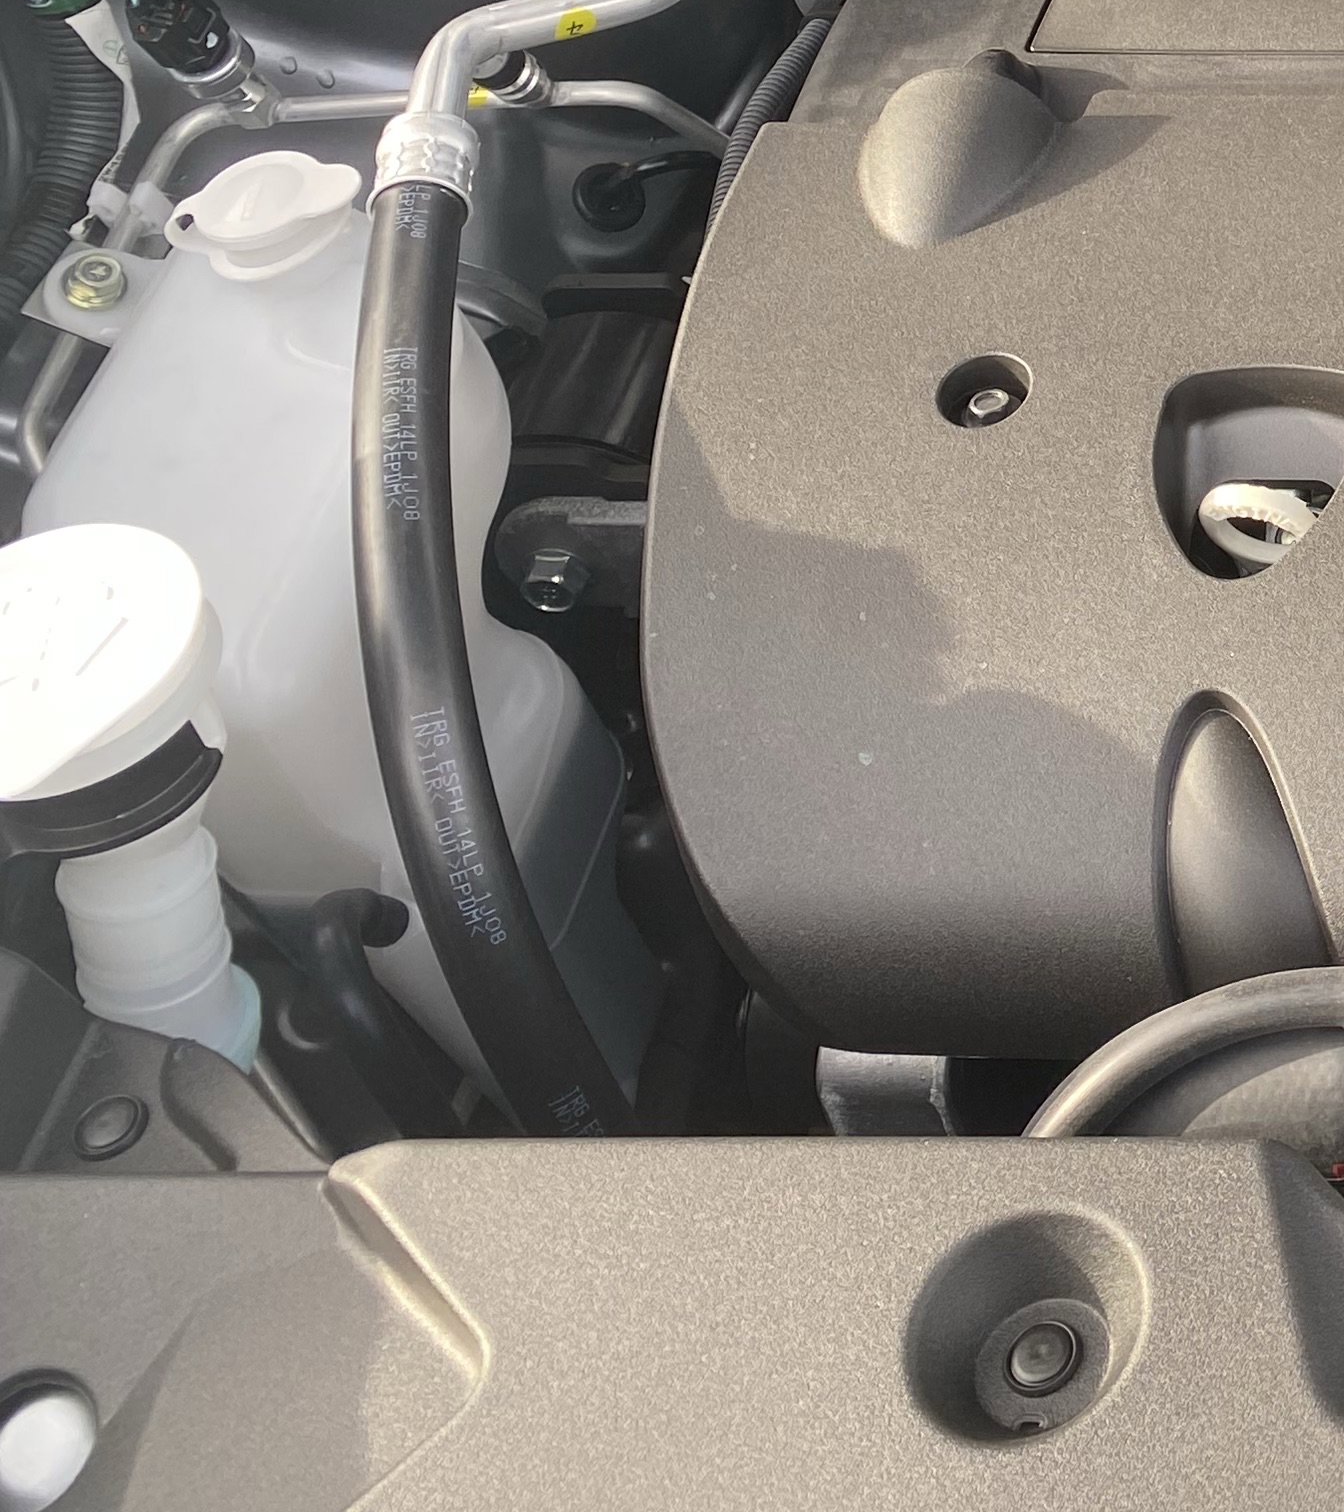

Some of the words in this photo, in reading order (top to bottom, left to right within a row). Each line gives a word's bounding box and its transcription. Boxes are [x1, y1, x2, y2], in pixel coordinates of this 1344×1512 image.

[400, 424, 418, 461] 14LP
[439, 759, 466, 814] ESFH
[456, 828, 484, 877] 14LP
